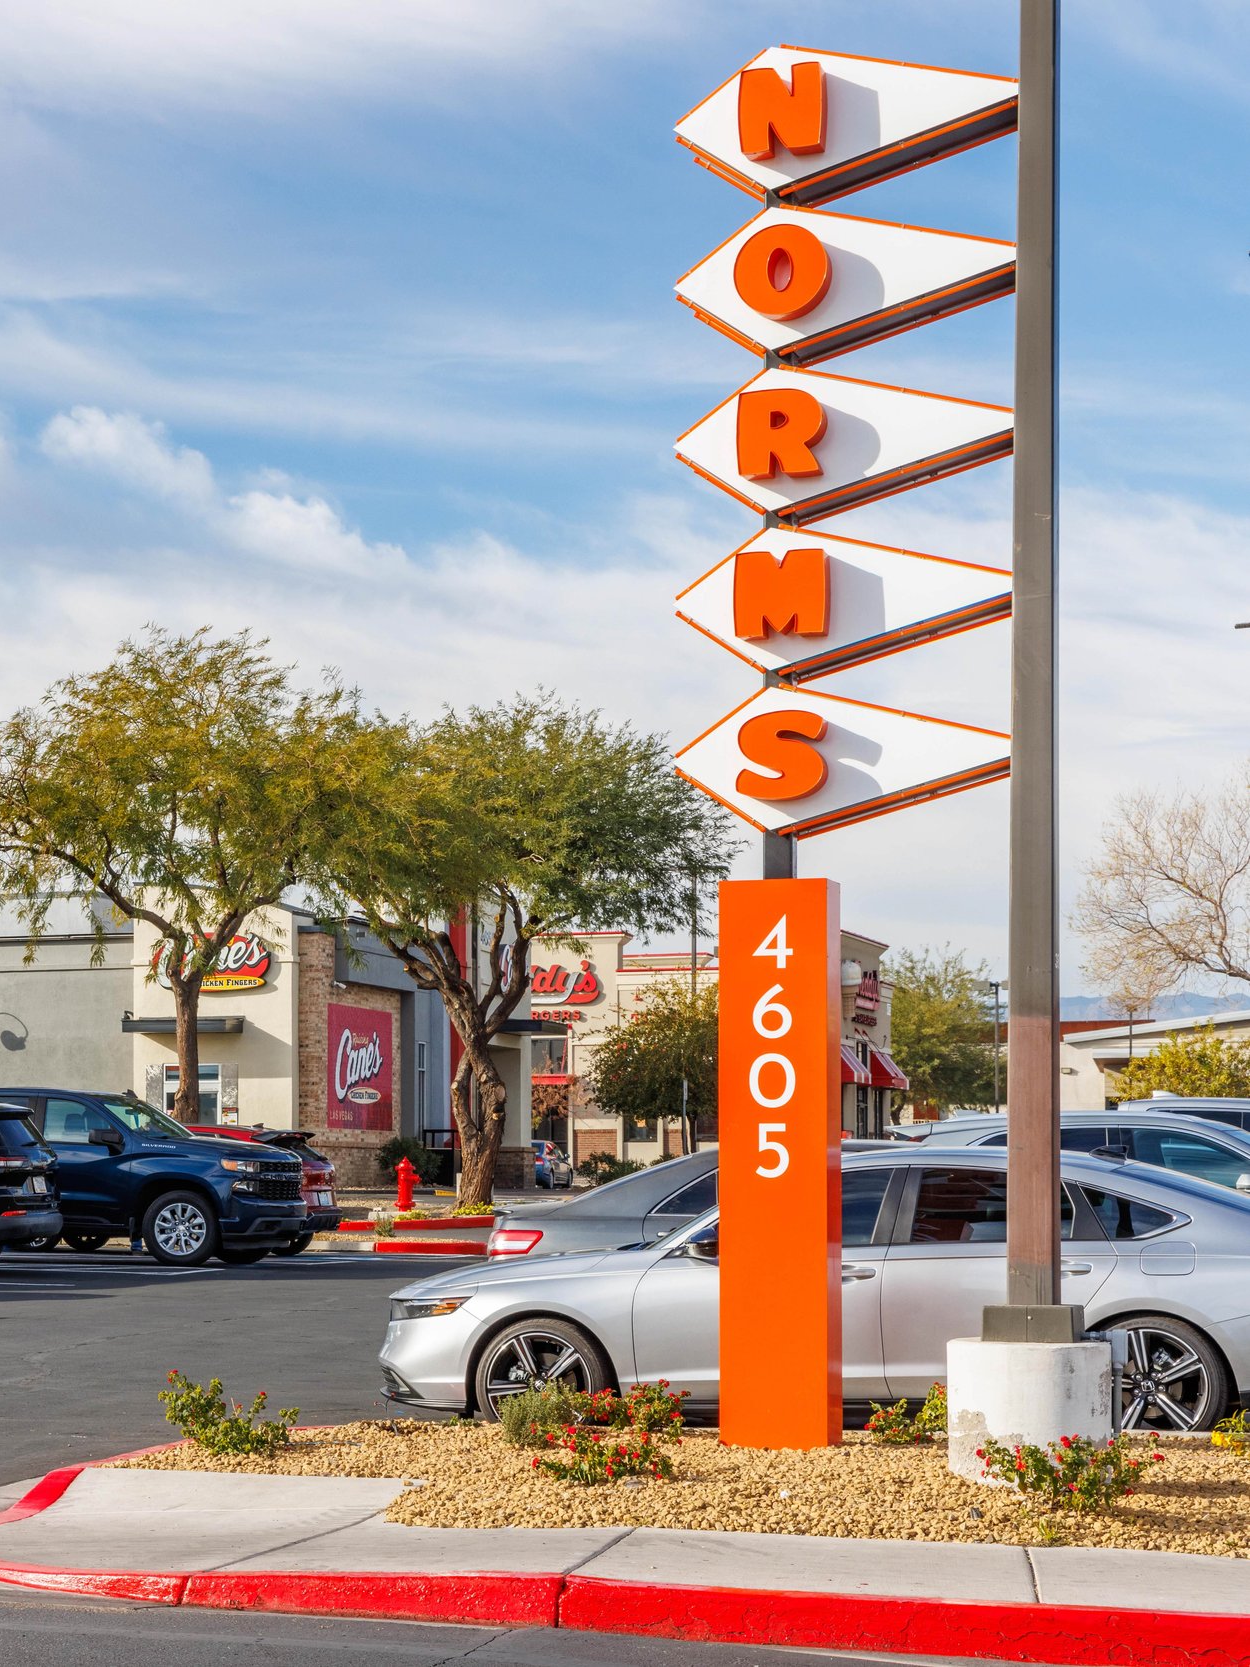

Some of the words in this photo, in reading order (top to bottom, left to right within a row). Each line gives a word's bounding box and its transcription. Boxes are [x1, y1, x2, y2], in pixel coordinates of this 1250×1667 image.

[733, 61, 832, 801] NORMS
[335, 1028, 383, 1101] Cane's
[531, 1009, 581, 1021] RGERS
[749, 914, 796, 1179] 4605
